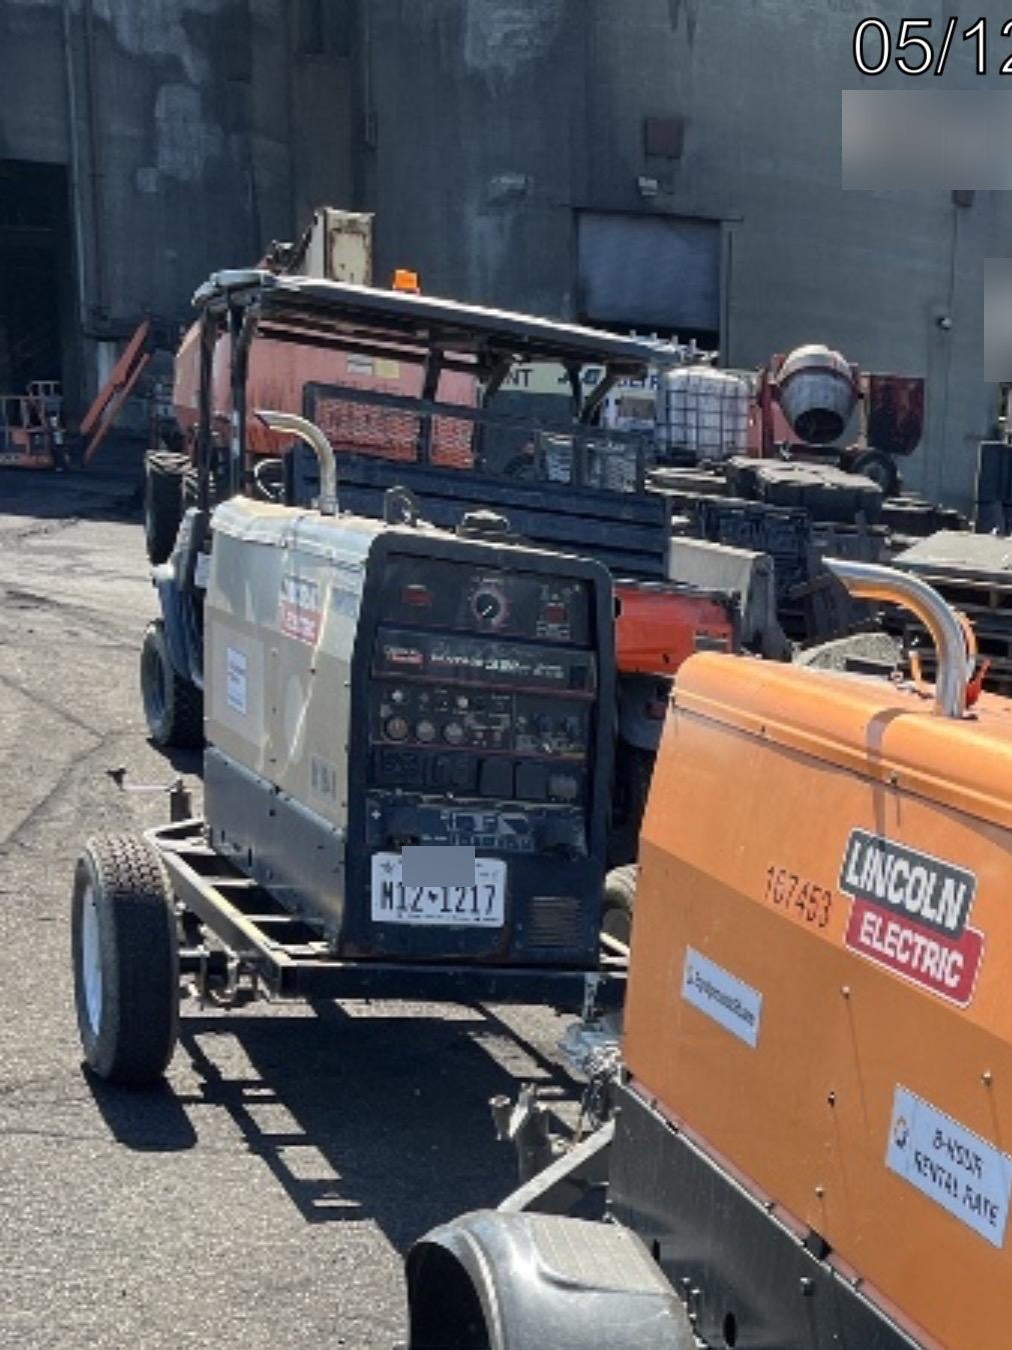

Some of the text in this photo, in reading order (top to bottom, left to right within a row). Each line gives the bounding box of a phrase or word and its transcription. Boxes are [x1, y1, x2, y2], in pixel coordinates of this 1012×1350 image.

[764, 865, 833, 928] 167453
[846, 841, 967, 931] LINCOLN
[859, 910, 964, 988] ELECTRIC
[914, 1150, 1000, 1229] RENTAL RATE
